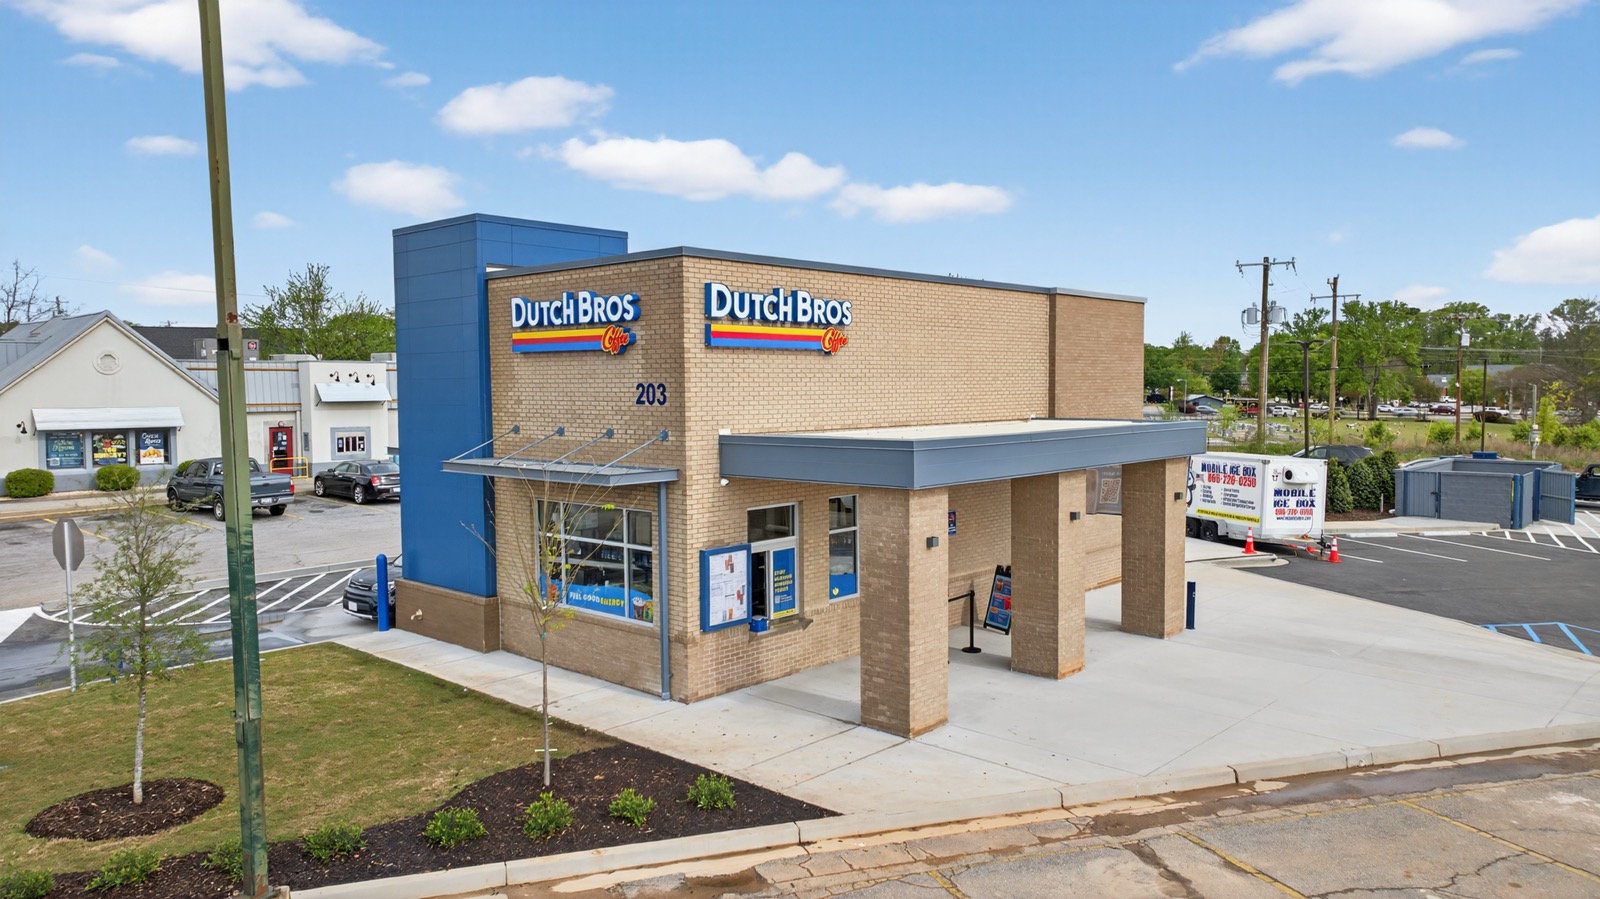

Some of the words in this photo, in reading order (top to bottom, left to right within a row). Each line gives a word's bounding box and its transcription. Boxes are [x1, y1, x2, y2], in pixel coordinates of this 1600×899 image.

[511, 291, 575, 328] DUTCH
[578, 290, 638, 324] BROS
[710, 282, 793, 322] DUTCH
[796, 289, 853, 326] BROS
[635, 382, 667, 406] 203
[1201, 462, 1228, 475] MOBILE
[1242, 466, 1257, 478] BOX
[1273, 488, 1316, 498] MOBILE
[1273, 499, 1290, 508] ICE
[1295, 499, 1316, 508] BOX
